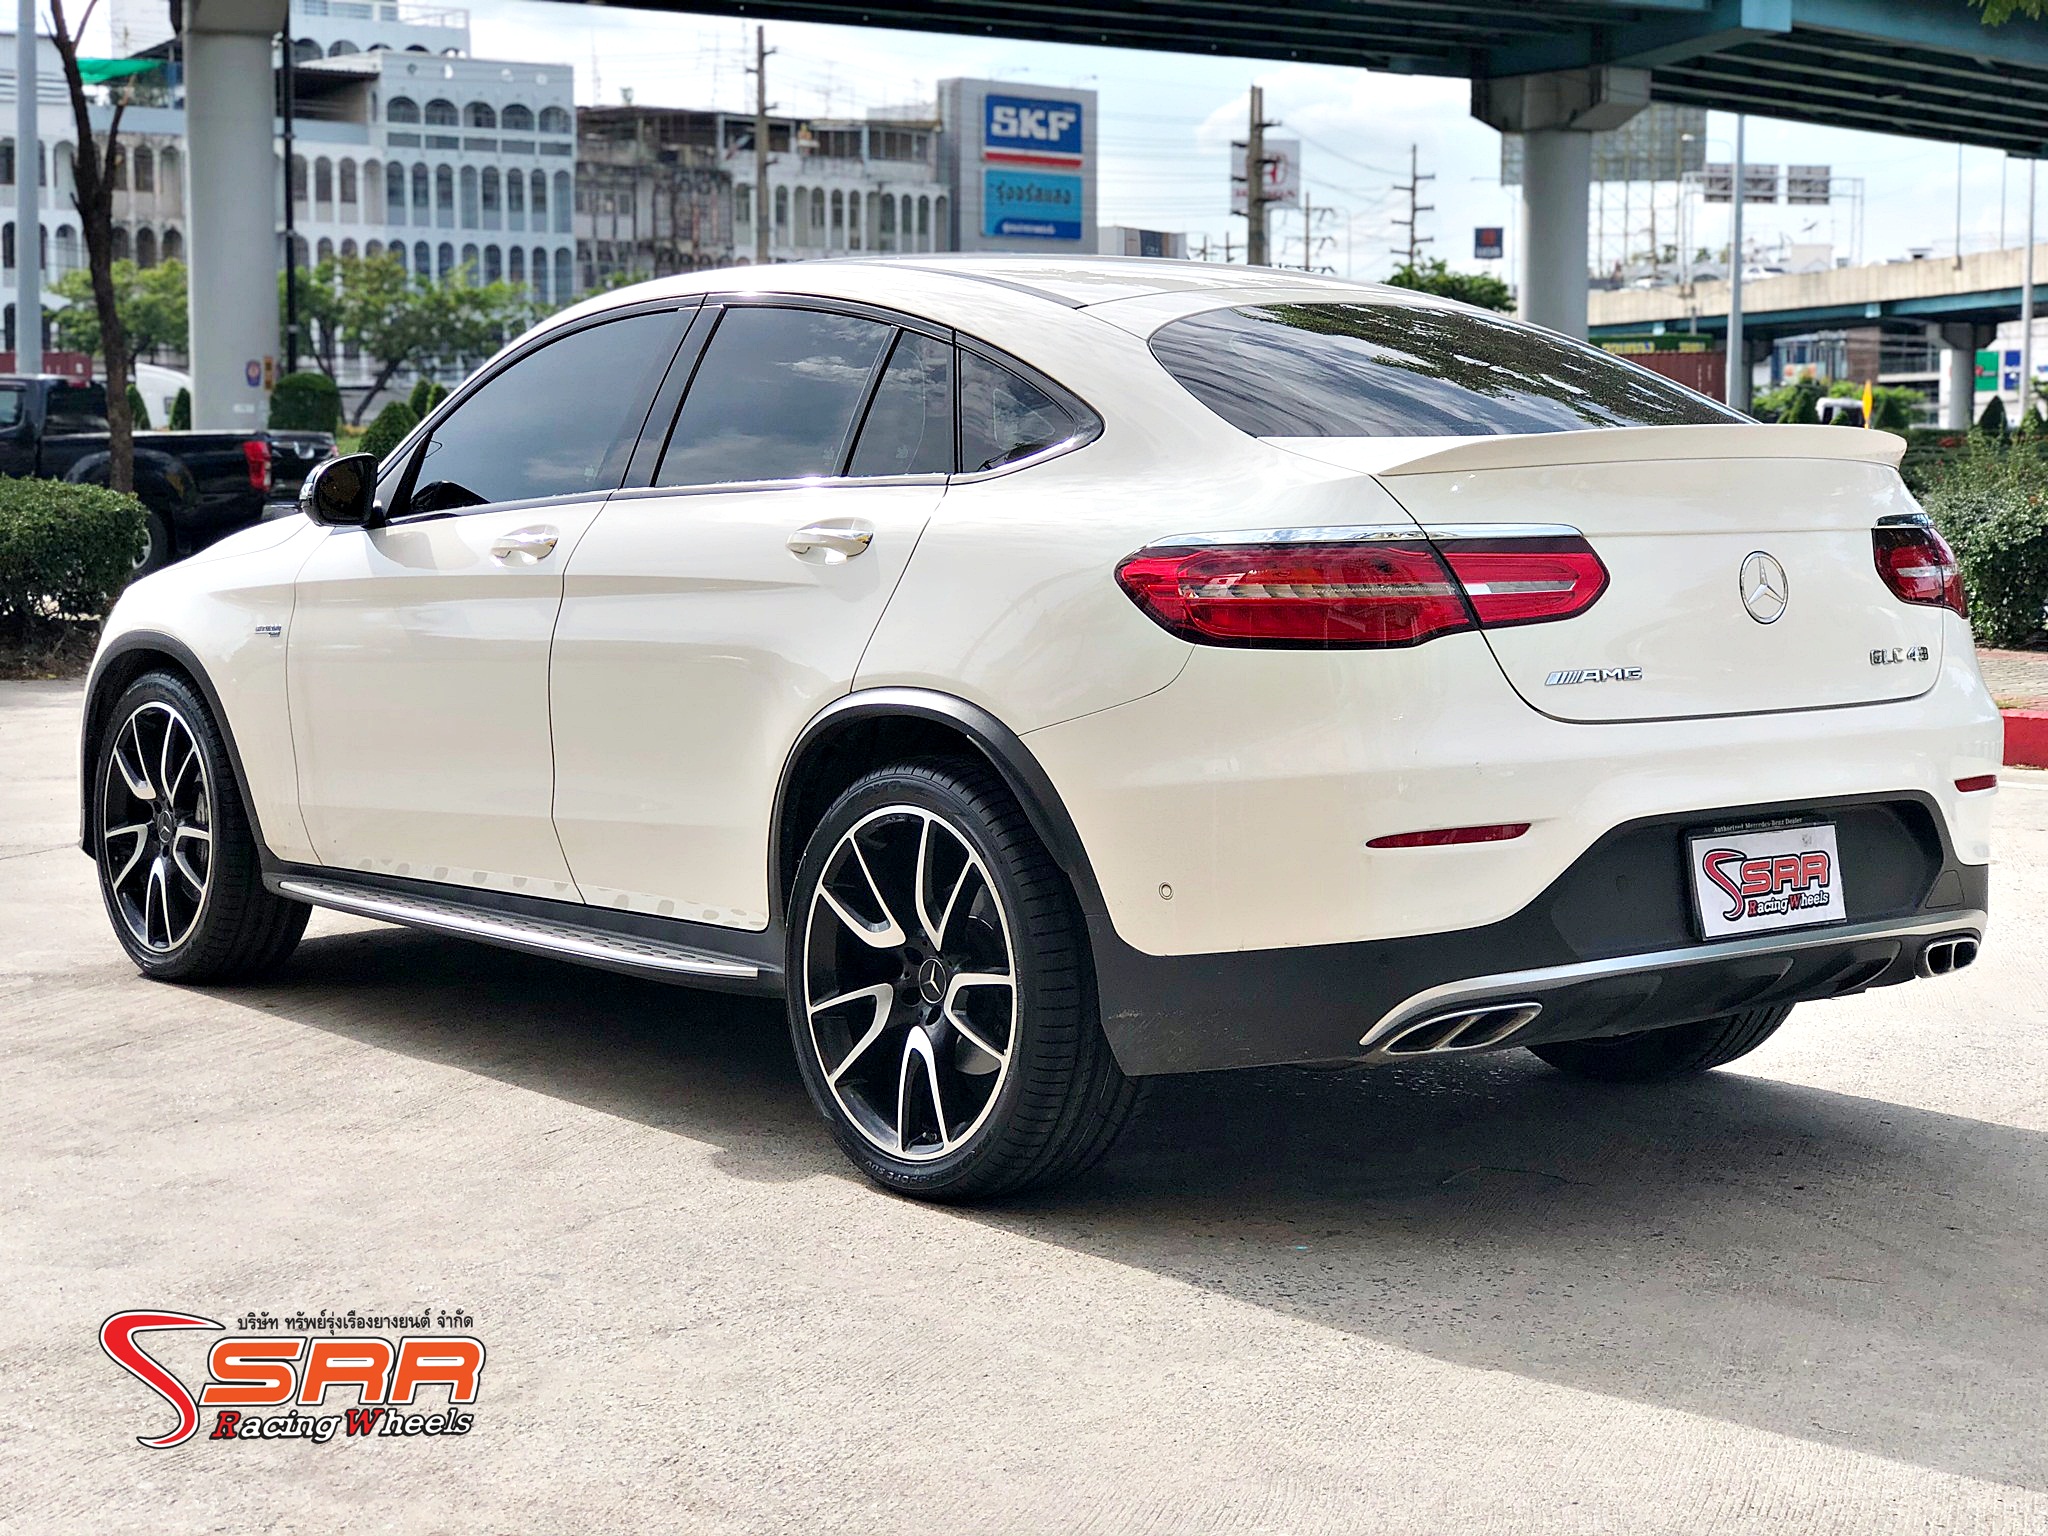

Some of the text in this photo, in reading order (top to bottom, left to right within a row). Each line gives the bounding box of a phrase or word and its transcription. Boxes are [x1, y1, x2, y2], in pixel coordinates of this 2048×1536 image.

[991, 105, 1077, 141] SKF
[1869, 646, 1929, 665] GLC 43
[1579, 667, 1643, 683] AMG
[1747, 891, 1830, 917] Racing Wheels
